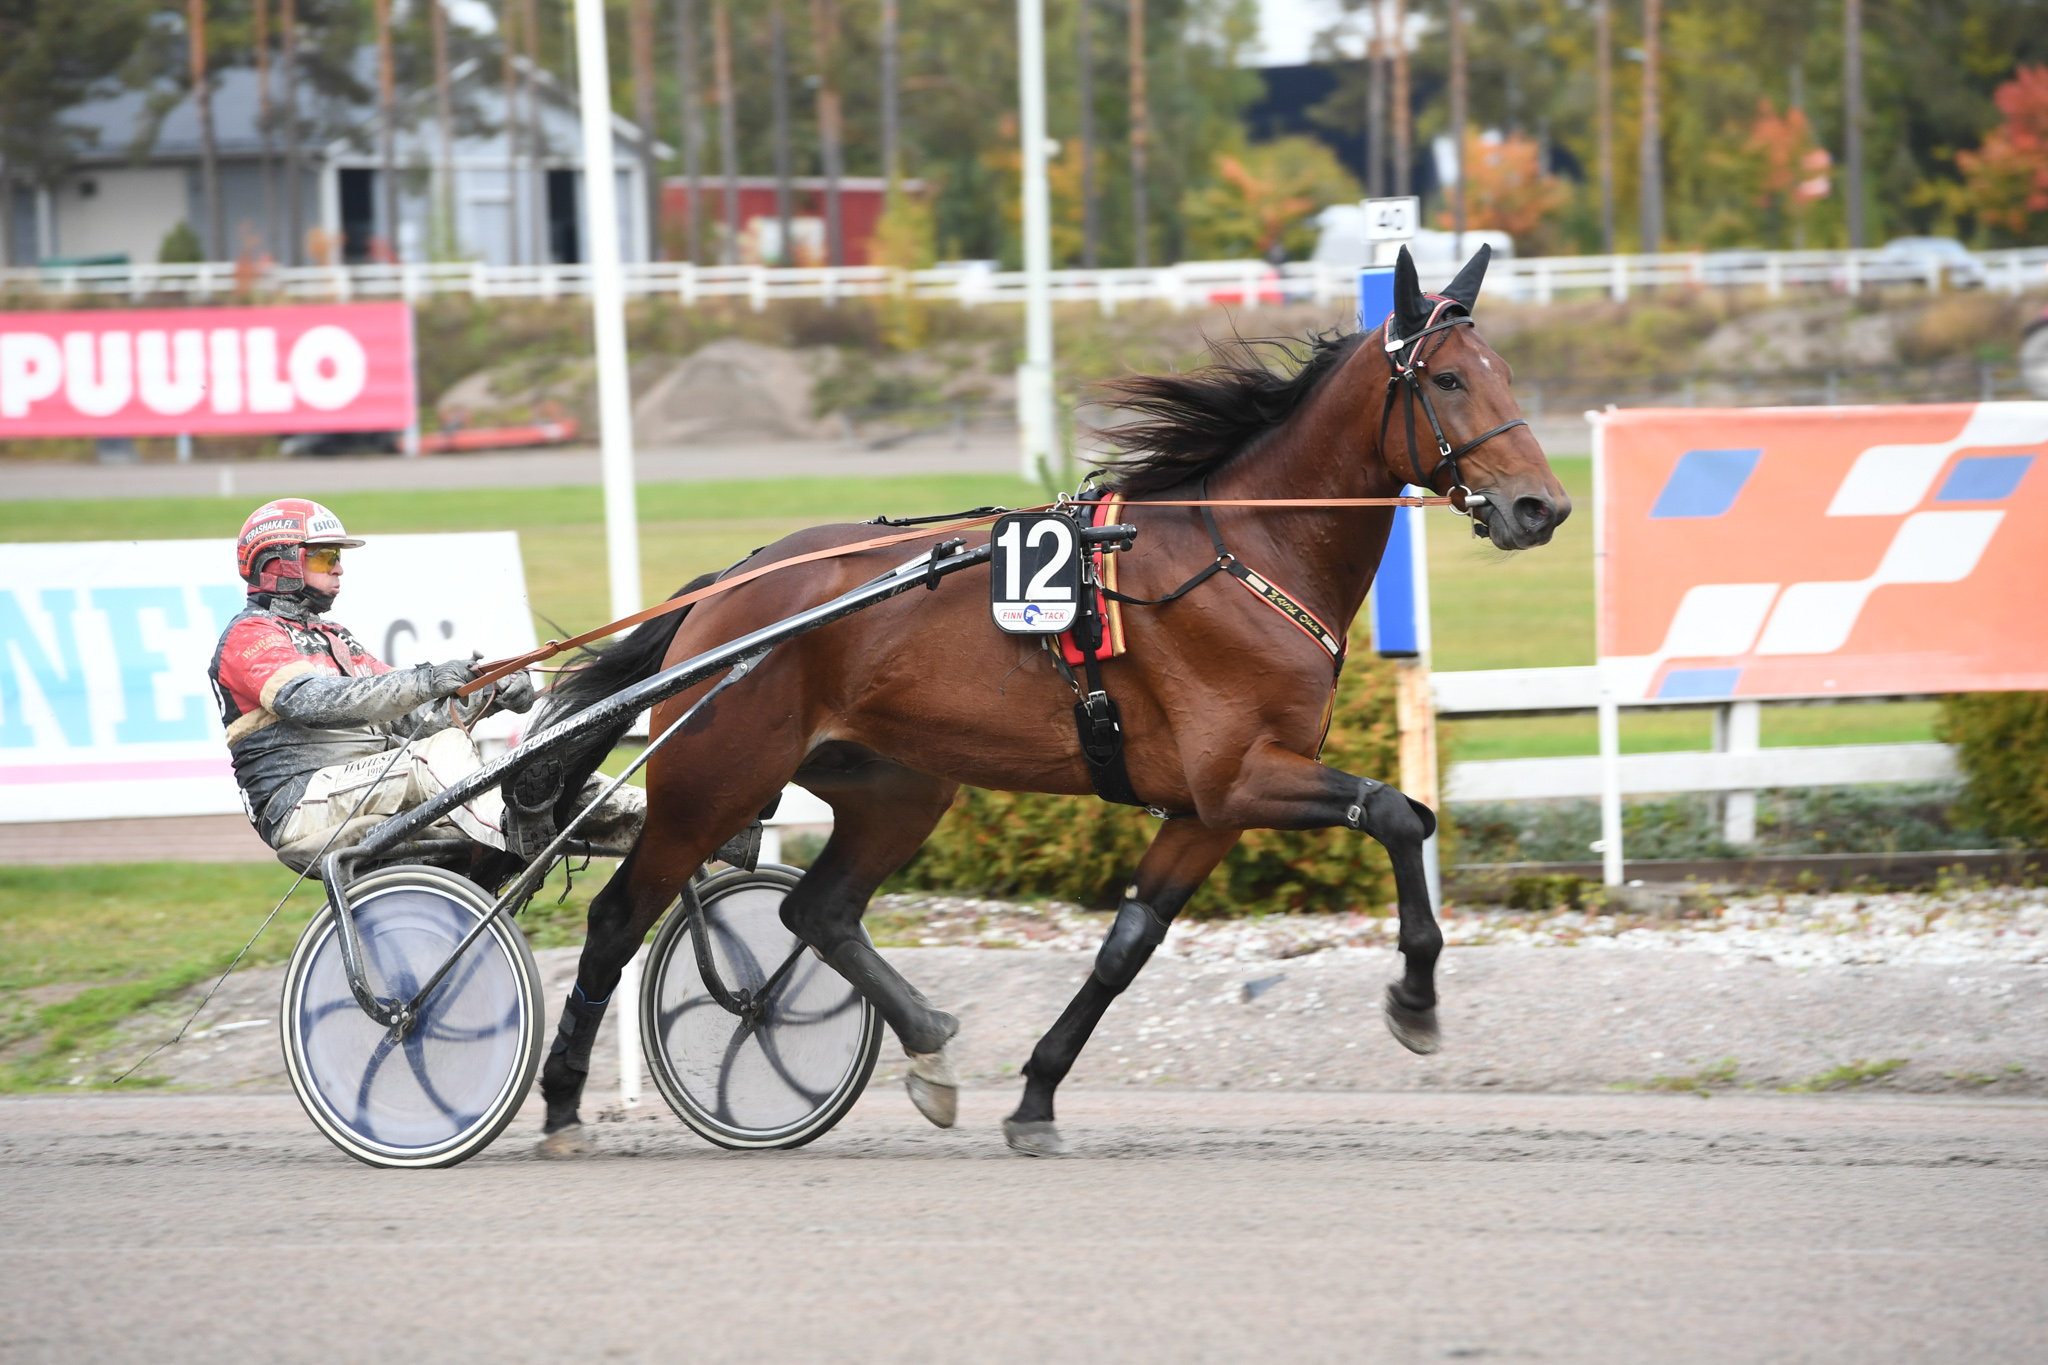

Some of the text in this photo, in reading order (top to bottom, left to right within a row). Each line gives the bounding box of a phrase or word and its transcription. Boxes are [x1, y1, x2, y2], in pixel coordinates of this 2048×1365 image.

[0, 324, 367, 418] PUUILO
[997, 519, 1073, 601] 12
[1002, 611, 1065, 620] FINN TACK
[366, 765, 384, 777] 1918
